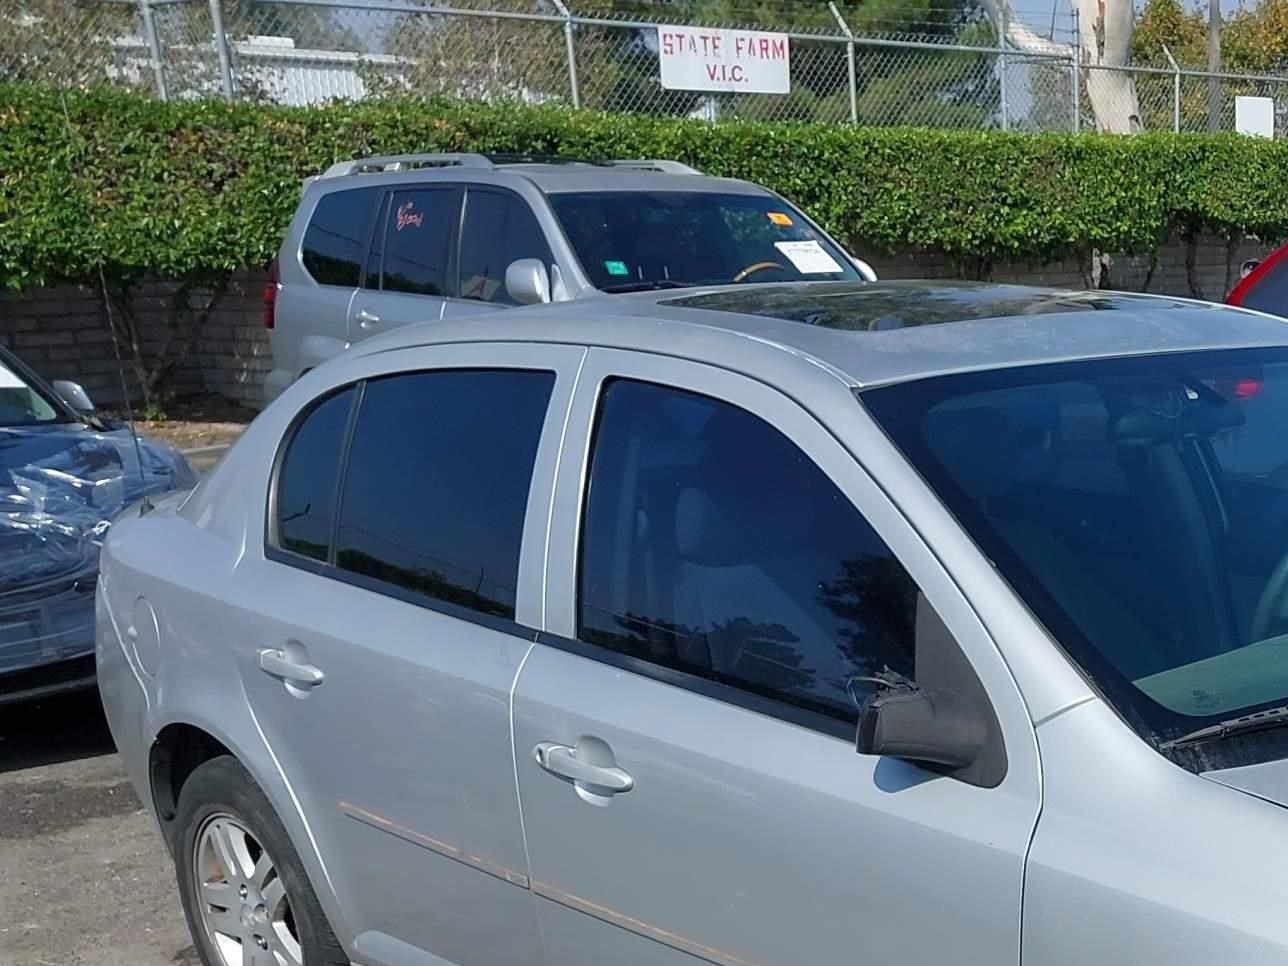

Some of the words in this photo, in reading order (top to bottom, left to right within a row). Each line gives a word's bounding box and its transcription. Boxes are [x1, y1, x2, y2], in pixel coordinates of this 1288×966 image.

[663, 32, 722, 58] STATE
[735, 37, 786, 60] FARM
[706, 63, 749, 82] V.I.C.
